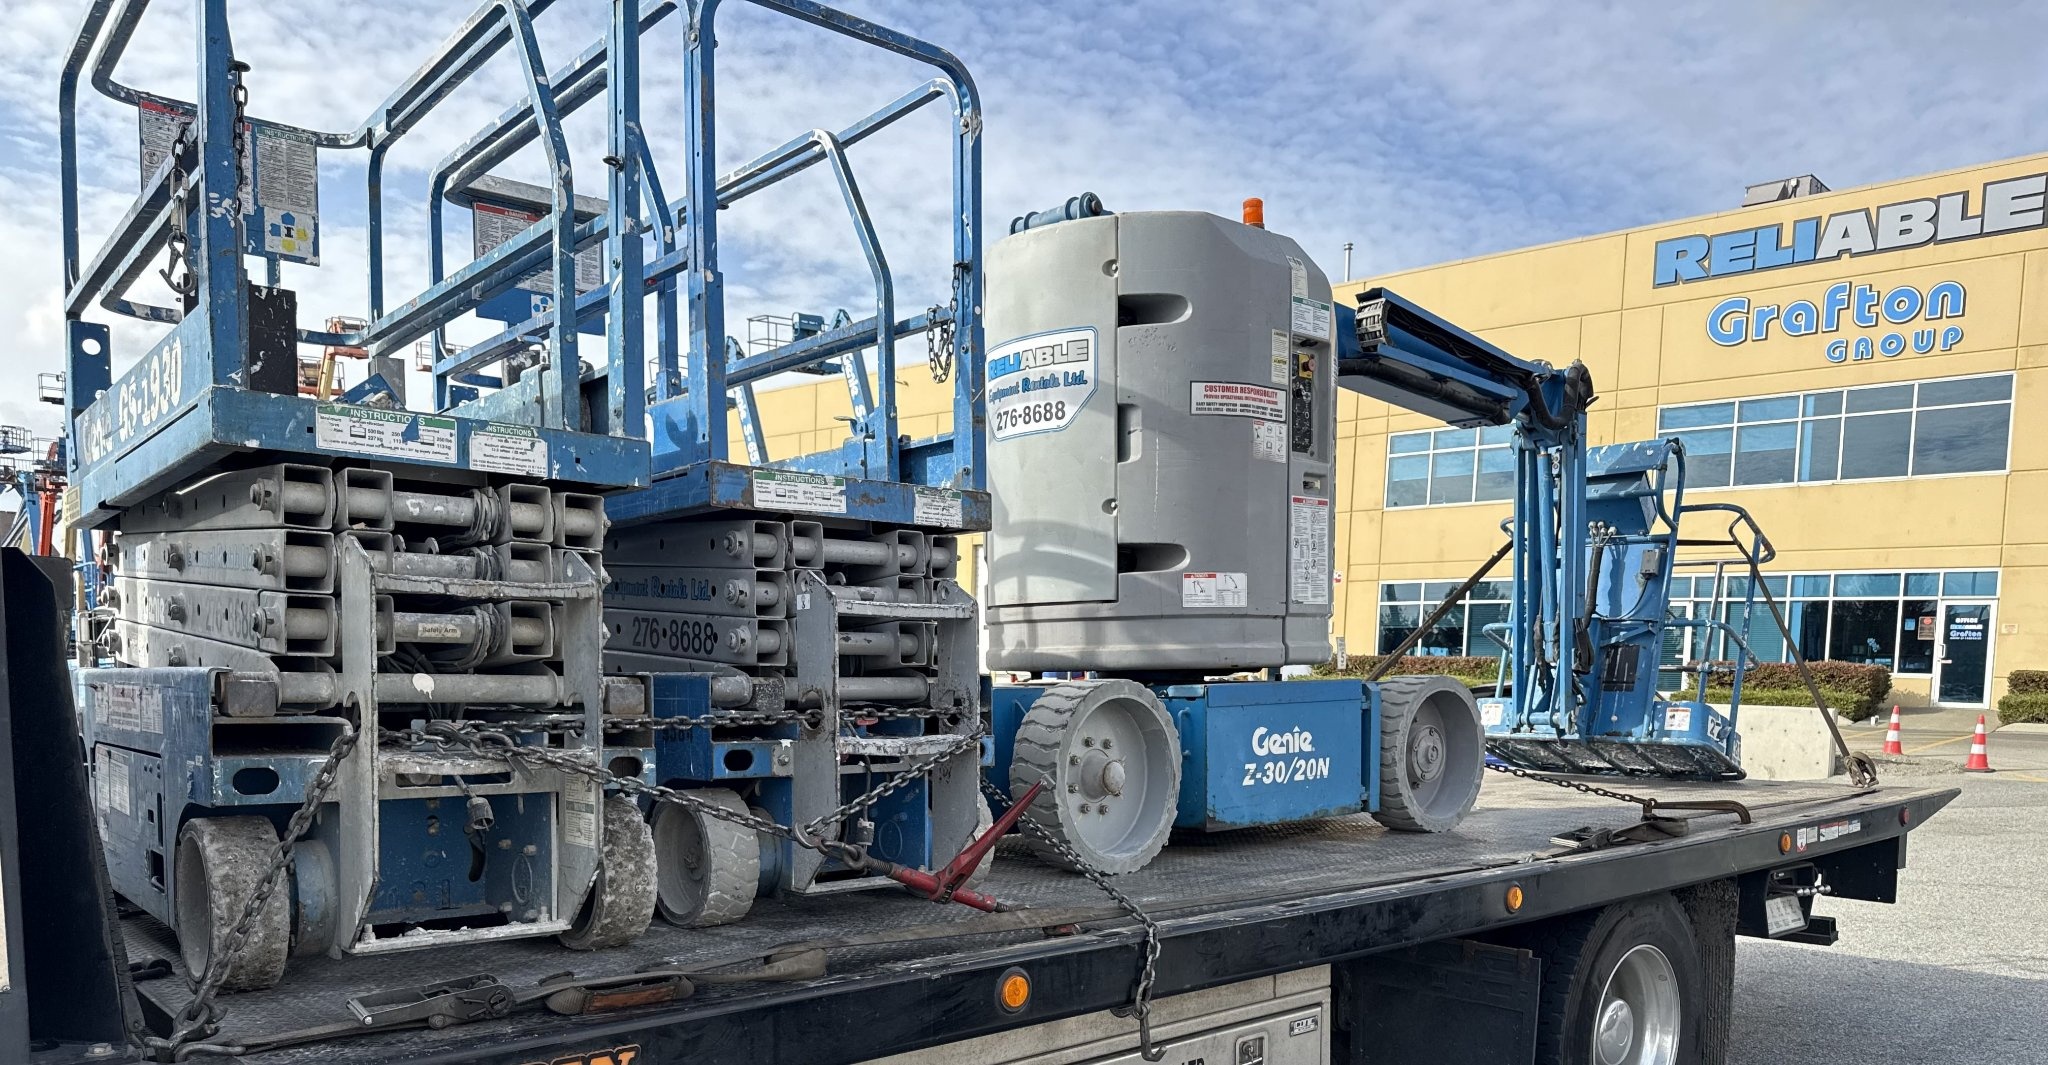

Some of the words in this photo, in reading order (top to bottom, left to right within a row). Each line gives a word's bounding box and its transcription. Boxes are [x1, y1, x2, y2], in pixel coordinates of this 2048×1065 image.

[1653, 172, 2048, 289] RELIABLE
[1706, 281, 1966, 346] Grafton
[987, 338, 1089, 382] RELIABLE
[1825, 325, 1964, 363] GROUP
[118, 335, 183, 443] GS-1930
[1021, 373, 1061, 393] Rentals
[1063, 370, 1088, 387] Ltd.
[1204, 384, 1239, 394] CUSTOMER
[350, 408, 426, 426] INSTRUCTIOS
[996, 400, 1066, 432] 276-8688
[775, 473, 825, 485] INSTRUCTIONS
[443, 626, 458, 634] Arm
[1252, 725, 1313, 757] Genie
[1242, 756, 1331, 787] Z-30/20N
